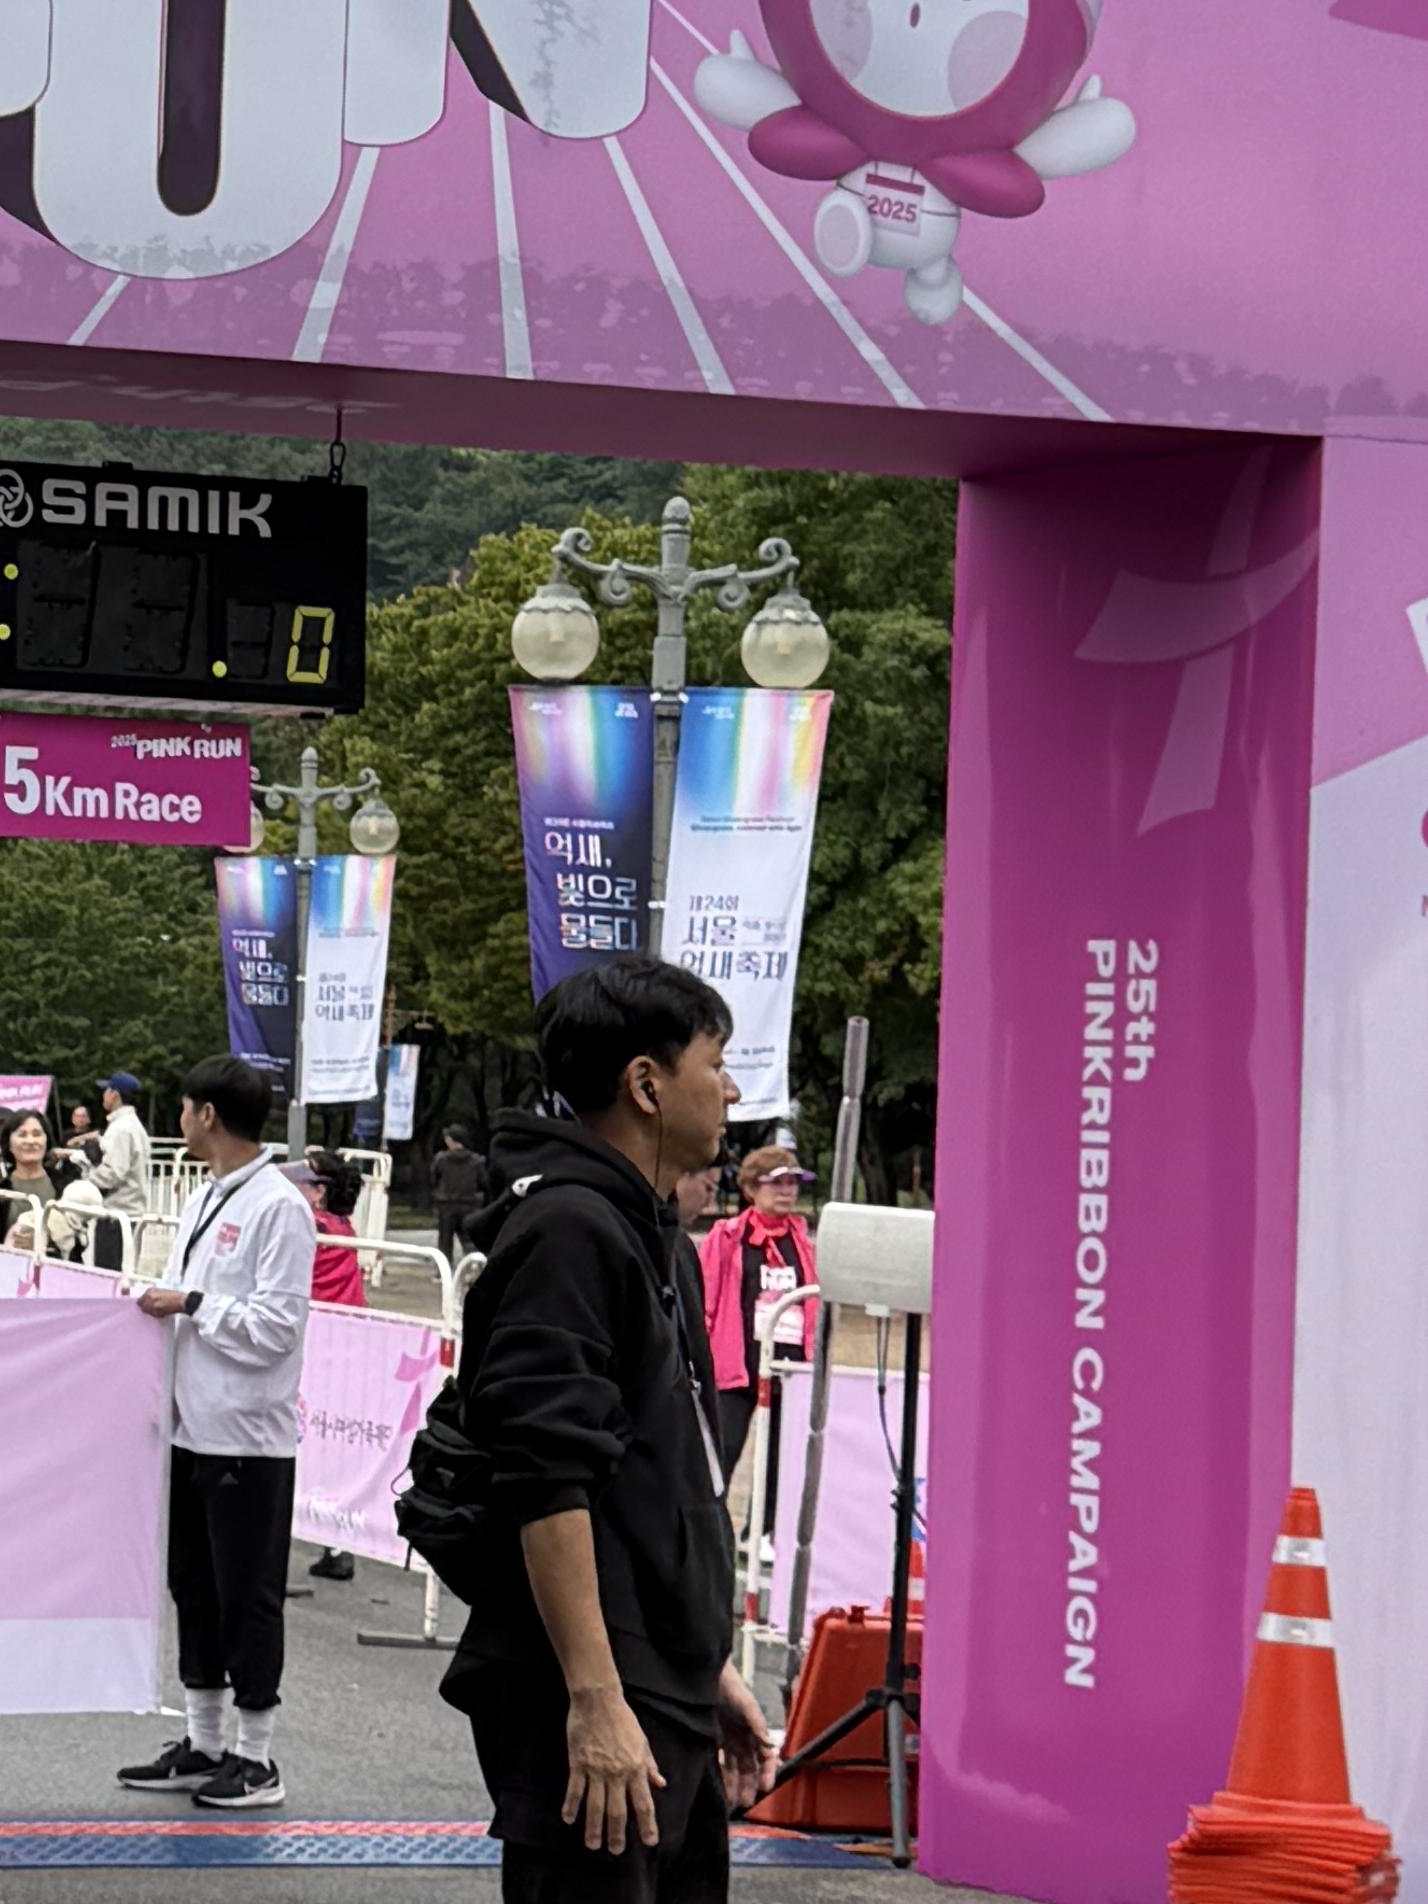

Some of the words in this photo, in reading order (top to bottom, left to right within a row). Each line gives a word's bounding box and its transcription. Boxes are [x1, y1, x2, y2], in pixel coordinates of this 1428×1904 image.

[866, 194, 918, 224] 2025
[41, 479, 273, 539] SAMIK
[287, 606, 335, 684] 0
[136, 737, 192, 761] PINK
[192, 735, 243, 759] RUN
[114, 782, 202, 825] Race
[544, 831, 612, 868] 억새,
[556, 873, 638, 911] 빛으로
[681, 916, 736, 947] 서울
[1123, 938, 1160, 1083] 25th
[1073, 938, 1117, 1332] PINKRIBBON
[1063, 1346, 1106, 1690] CAMPAIGN
